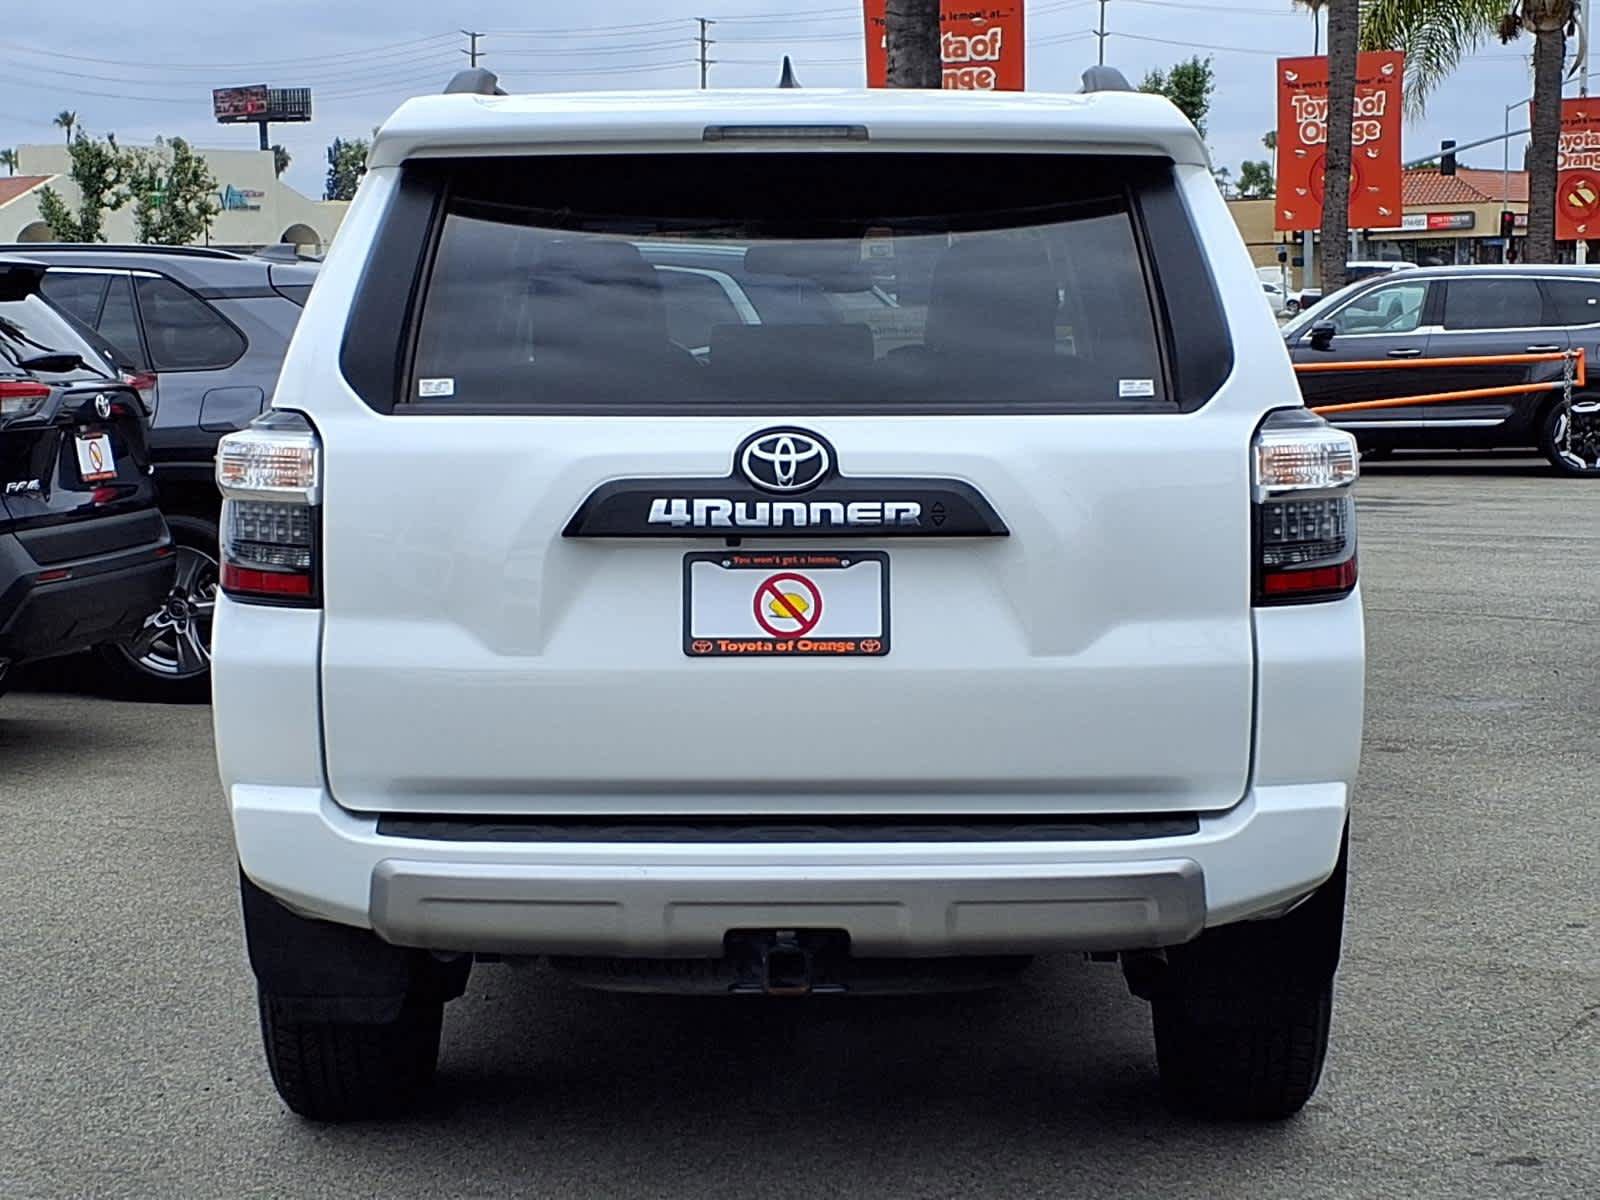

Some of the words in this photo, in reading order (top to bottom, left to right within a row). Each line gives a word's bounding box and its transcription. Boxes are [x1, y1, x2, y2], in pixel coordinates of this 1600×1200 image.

[969, 27, 1002, 61] of
[942, 67, 997, 89] nge
[1361, 90, 1386, 116] of
[733, 555, 751, 564] You
[753, 555, 780, 564] won't
[782, 556, 798, 566] get
[717, 640, 773, 652] Toyota
[775, 640, 794, 652] of
[797, 640, 855, 653] Orange
